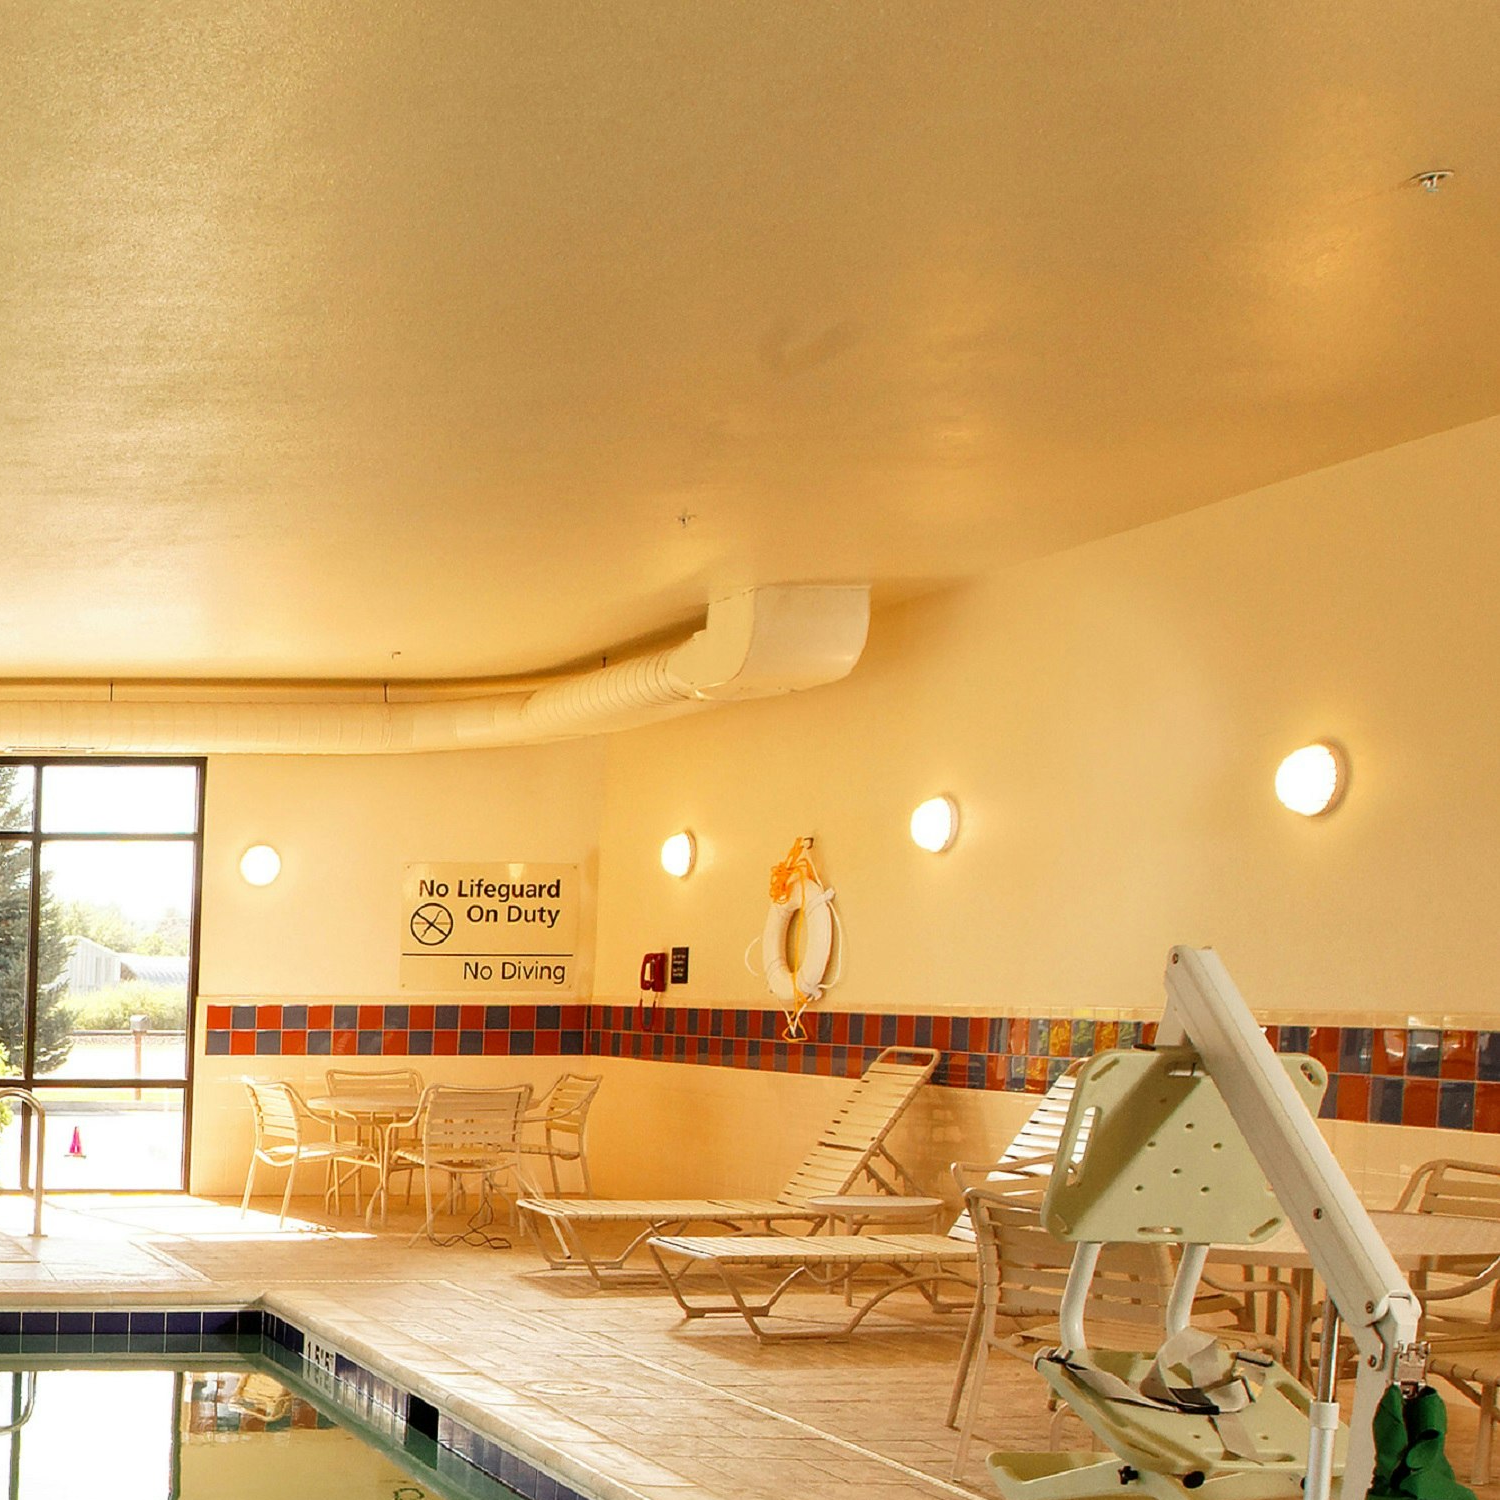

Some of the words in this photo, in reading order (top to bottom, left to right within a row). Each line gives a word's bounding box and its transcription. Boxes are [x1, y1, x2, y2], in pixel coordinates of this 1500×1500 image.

[419, 879, 449, 898] No
[458, 878, 561, 903] Lifeguard
[466, 905, 498, 923] On
[507, 905, 561, 928] Duty
[463, 961, 493, 980] No
[501, 961, 566, 985] Diving
